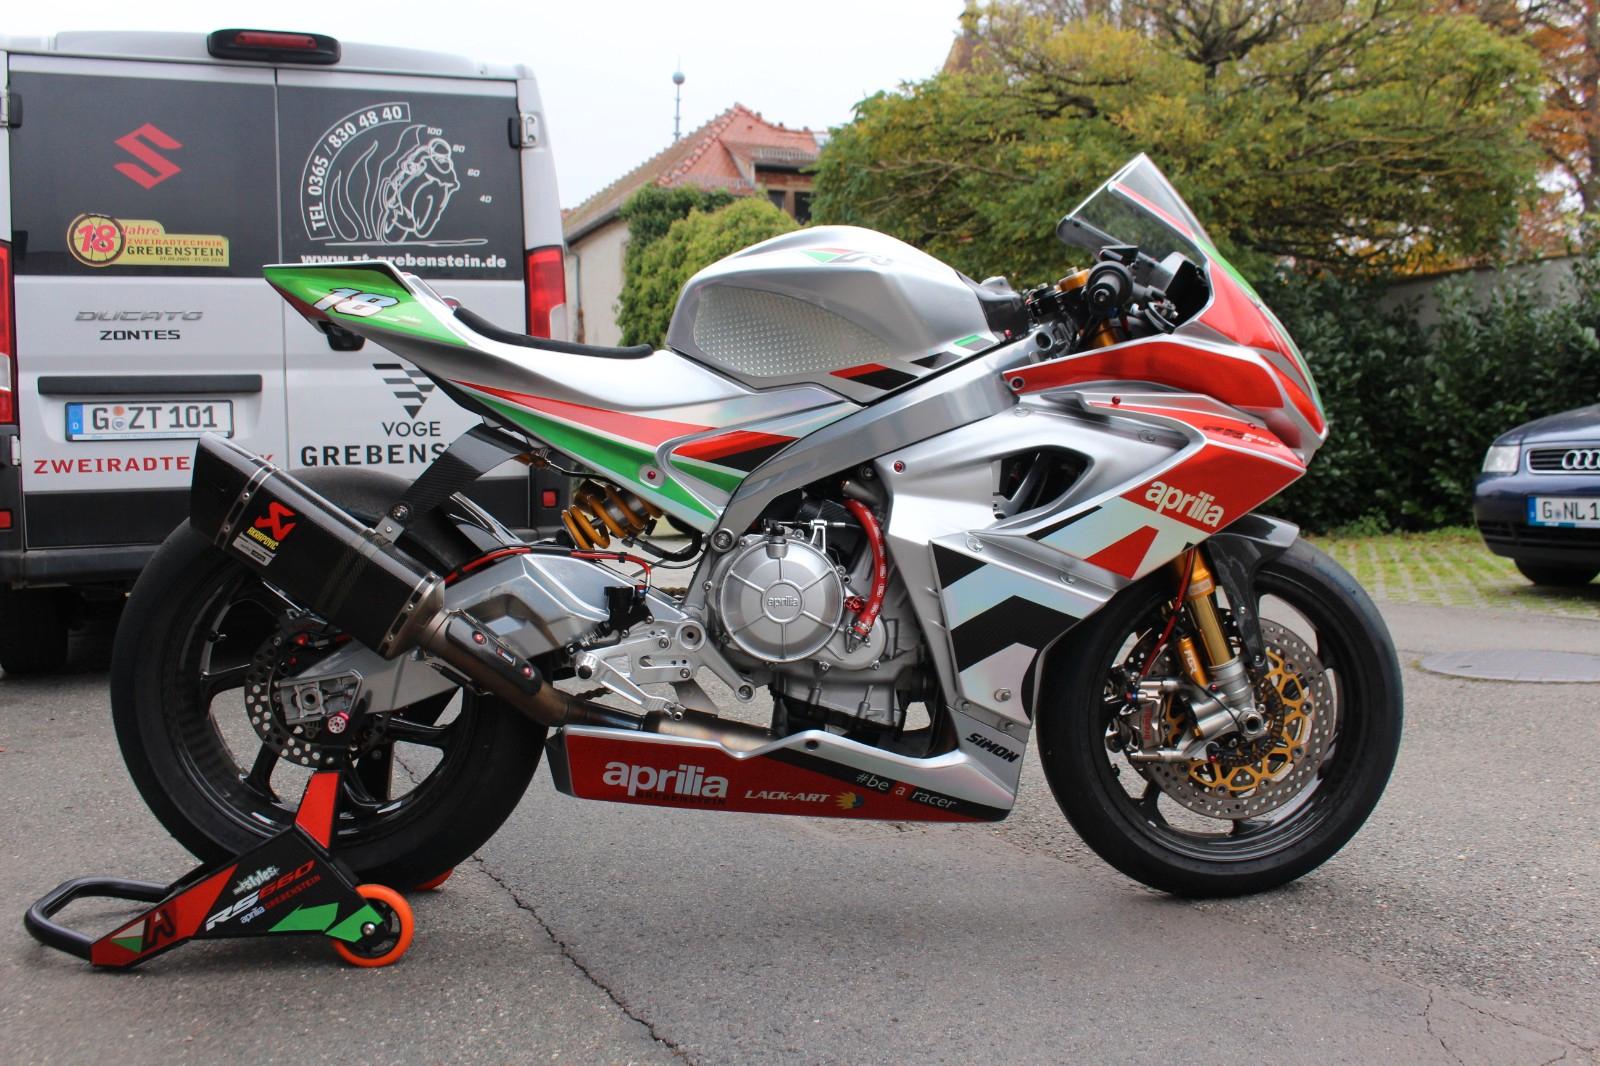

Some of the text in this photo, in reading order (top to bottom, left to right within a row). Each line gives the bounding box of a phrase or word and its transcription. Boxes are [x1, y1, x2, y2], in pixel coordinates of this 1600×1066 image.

[359, 110, 379, 128] 48
[382, 105, 403, 121] 40
[328, 121, 357, 148] 830
[427, 127, 443, 136] 100
[308, 155, 329, 196] 0365
[480, 195, 493, 204] 40
[308, 202, 327, 231] TEL
[77, 224, 117, 254] 18
[127, 246, 225, 257] GREBENSTEIN
[312, 287, 400, 317] 18
[75, 311, 204, 321] DUCATO
[100, 329, 182, 341] ZONTES
[93, 405, 218, 430] G ZT 101
[382, 421, 442, 437] VOGE
[33, 453, 274, 475] ZWEIRADTE
[301, 442, 452, 467] GREBENS
[1145, 480, 1225, 527] aprilia
[1542, 501, 1552, 519] G
[1563, 501, 1586, 520] NL
[767, 595, 799, 609] aprilia
[602, 761, 729, 799] aprilia
[744, 789, 832, 803] LACK-ART
[856, 772, 958, 809] #be a racer
[239, 905, 266, 924] aprilia
